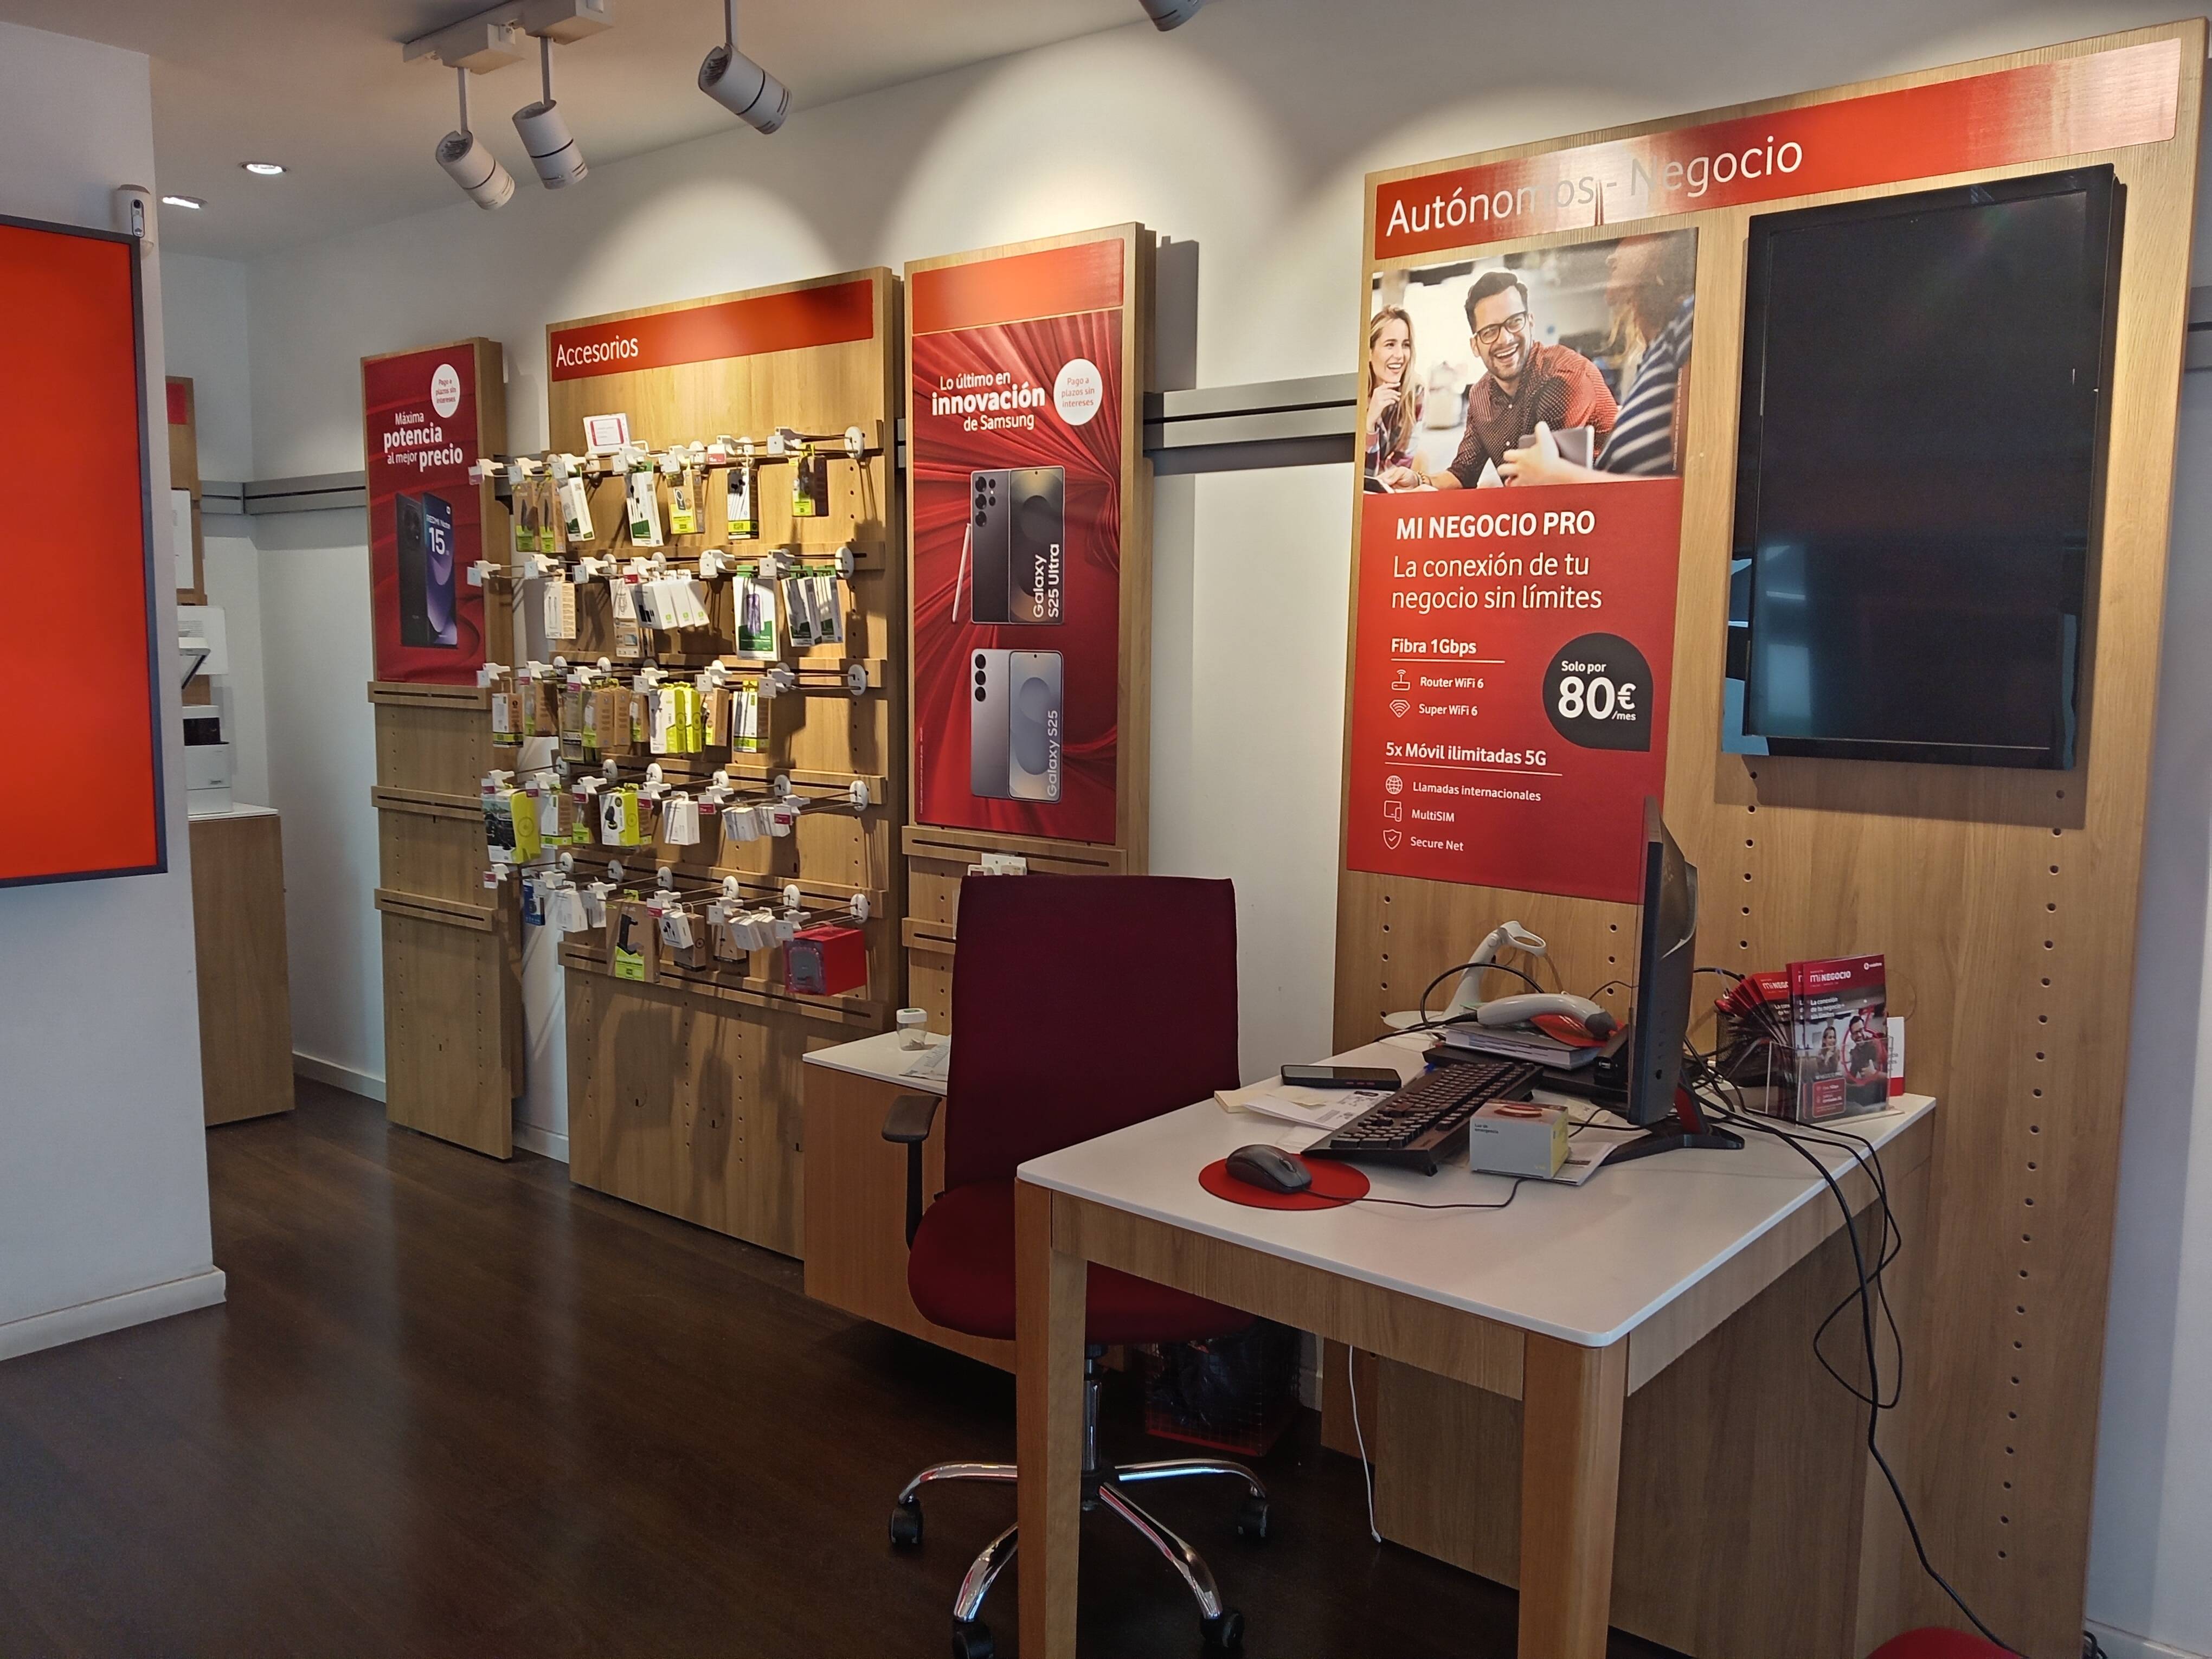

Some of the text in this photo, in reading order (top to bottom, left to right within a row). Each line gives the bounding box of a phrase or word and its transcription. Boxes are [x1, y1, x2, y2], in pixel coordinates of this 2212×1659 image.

[1385, 175, 1594, 237] Autónomos
[1630, 136, 1803, 198] Negocio
[556, 335, 639, 368] Accesorios
[940, 372, 1011, 391] Lo último en
[1061, 386, 1095, 398] plazos sin
[1066, 377, 1084, 386] Pago
[931, 382, 1046, 416] innovación
[1062, 398, 1094, 408] intereses
[395, 410, 425, 426] Máxima
[963, 414, 1034, 432] de Samsung
[383, 422, 442, 453] potencia
[387, 443, 463, 472] al mejor precio
[1396, 510, 1596, 540] MI NEGOCIO PRO
[428, 527, 445, 555] 15
[1393, 551, 1590, 578] La conexión de tu
[1033, 554, 1047, 618] Galaxy
[1047, 543, 1060, 618] S25 Ultra
[1392, 583, 1603, 614] negocio sin límites
[1391, 638, 1477, 658] Fibra 1Gbps
[1561, 660, 1606, 674] Solo por
[1420, 676, 1484, 689] Router WiFi 6
[1418, 703, 1478, 718] Super WiFi 6
[1611, 710, 1637, 721] /mes
[1047, 710, 1060, 797] Galaxy S25
[1385, 742, 1547, 766] 5x Móvil ilimitadas 5G
[1413, 781, 1541, 802] Llamadas internacionales
[1411, 809, 1455, 822] MultiSIM
[1410, 836, 1464, 851] Secure Net
